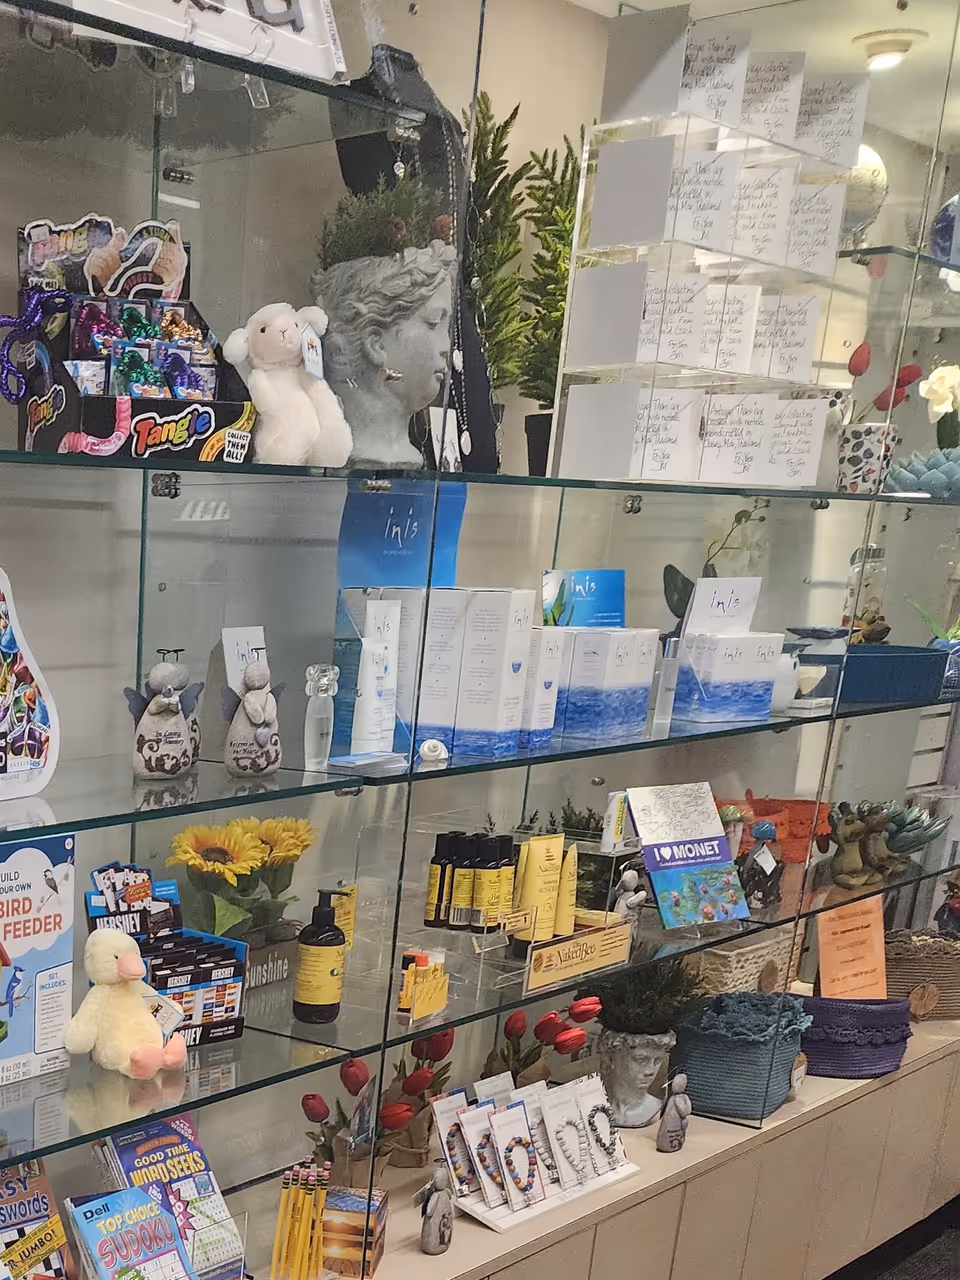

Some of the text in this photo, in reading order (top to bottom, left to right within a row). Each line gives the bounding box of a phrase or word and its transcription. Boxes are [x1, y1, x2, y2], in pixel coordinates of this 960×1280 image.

[135, 409, 211, 455] Tangle
[227, 431, 249, 443] COLLECT
[226, 440, 246, 452] THEM
[225, 450, 243, 462] ALL!
[385, 506, 418, 548] inis
[570, 575, 596, 597] inis
[711, 590, 740, 613] inis
[513, 608, 529, 628] inis
[724, 647, 743, 662] inis
[756, 646, 775, 661] inis
[653, 847, 661, 862] I
[673, 840, 720, 859] MONET
[14, 881, 33, 893] OWN
[3, 913, 63, 942] FEEDER
[96, 911, 141, 932] HERSHEY
[48, 972, 59, 981] SET
[167, 973, 192, 987] HERSHEY
[211, 966, 235, 981] HERSHEY
[39, 980, 67, 991] INCLUDES:
[134, 1152, 165, 1168] GOOD
[165, 1143, 191, 1157] TIME
[0, 1168, 12, 1179] &
[169, 1151, 206, 1180] SEEKS
[82, 1202, 111, 1221] Dell
[96, 1201, 160, 1236] TOP CHOICE
[96, 1217, 176, 1269] SUDOKU
